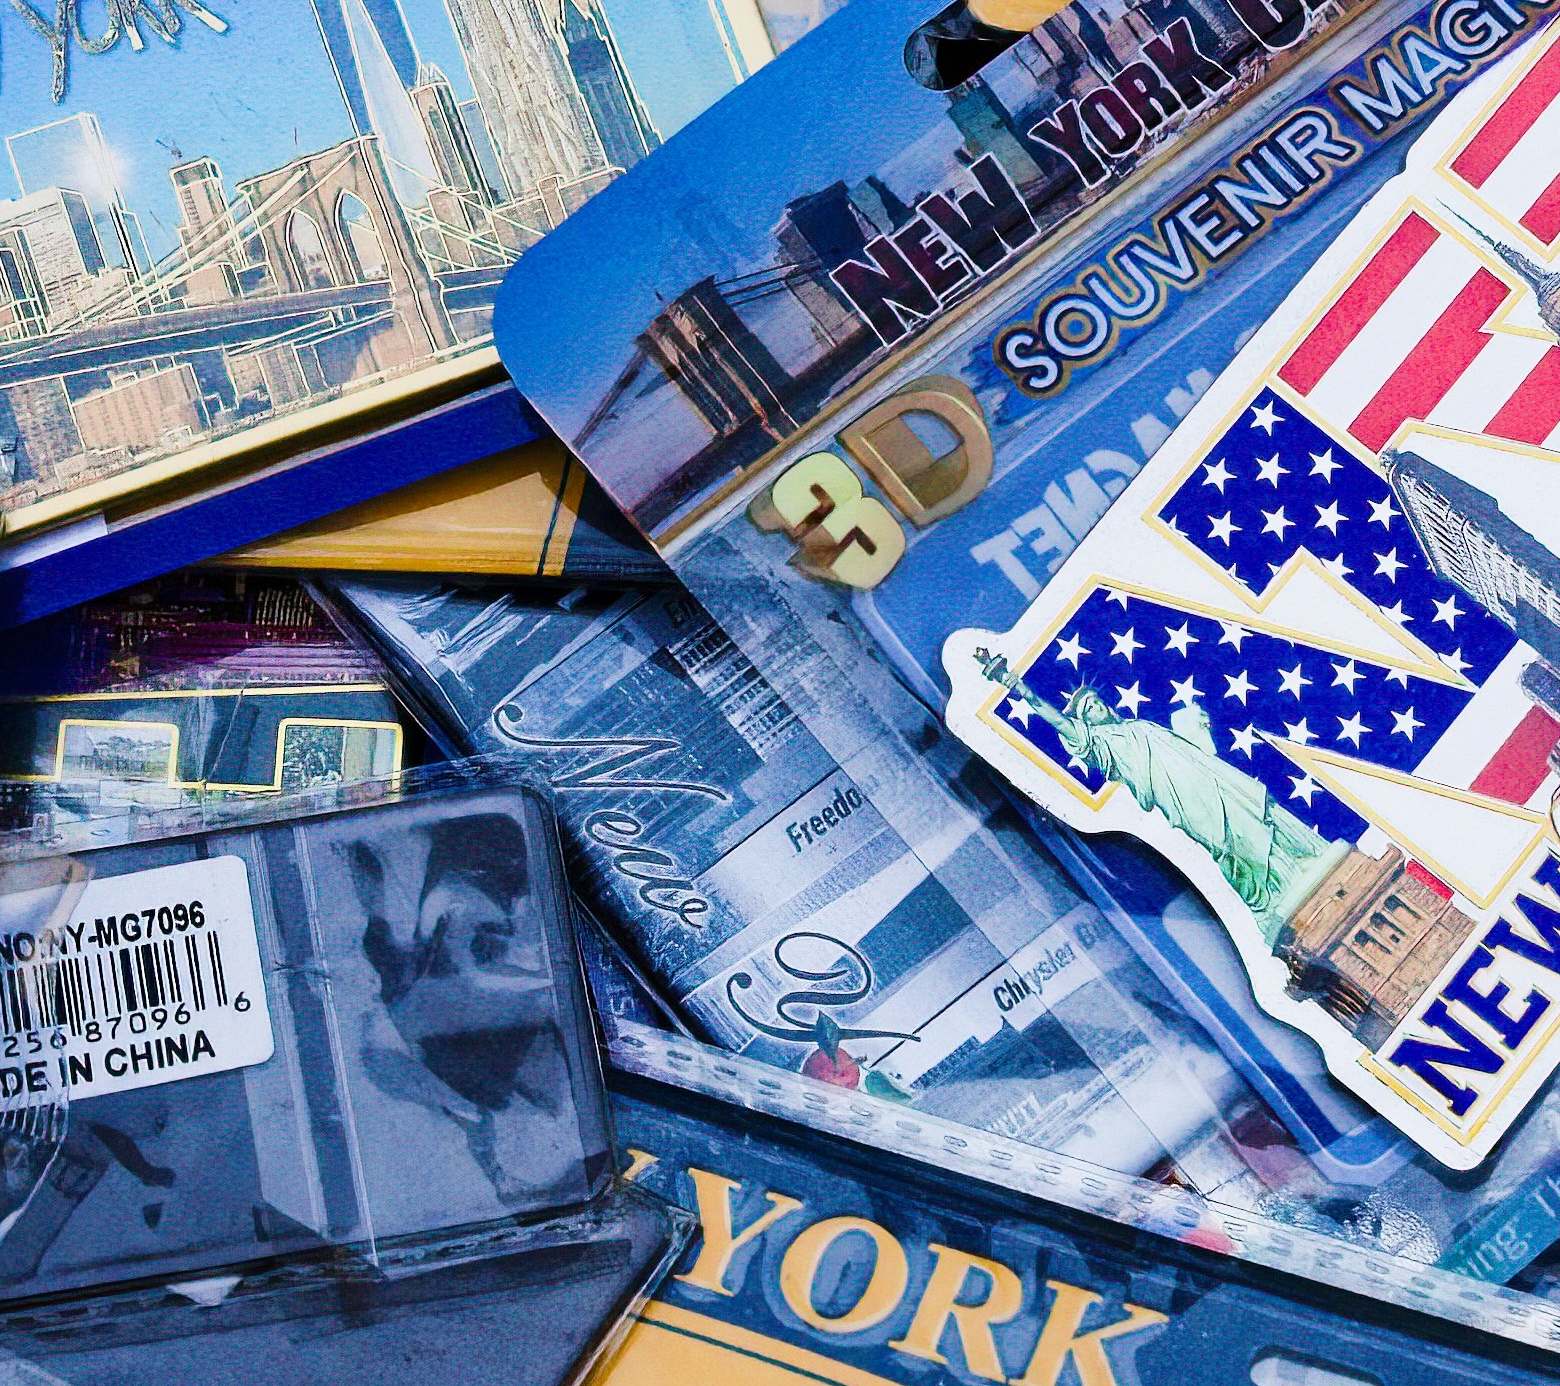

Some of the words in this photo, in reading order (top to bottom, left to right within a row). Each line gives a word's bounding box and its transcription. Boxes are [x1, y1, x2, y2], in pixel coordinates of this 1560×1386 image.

[829, 152, 1042, 349] NEW
[1028, 16, 1235, 191] YORK
[1000, 110, 1358, 399] SOUVENIR
[768, 370, 998, 589] 3D
[491, 702, 734, 931] New
[57, 1054, 97, 1089] IN
[104, 1028, 217, 1082] CHINA
[86, 1003, 195, 1046] 87096
[234, 991, 252, 1013] 6
[991, 931, 1077, 1014] Chrysler
